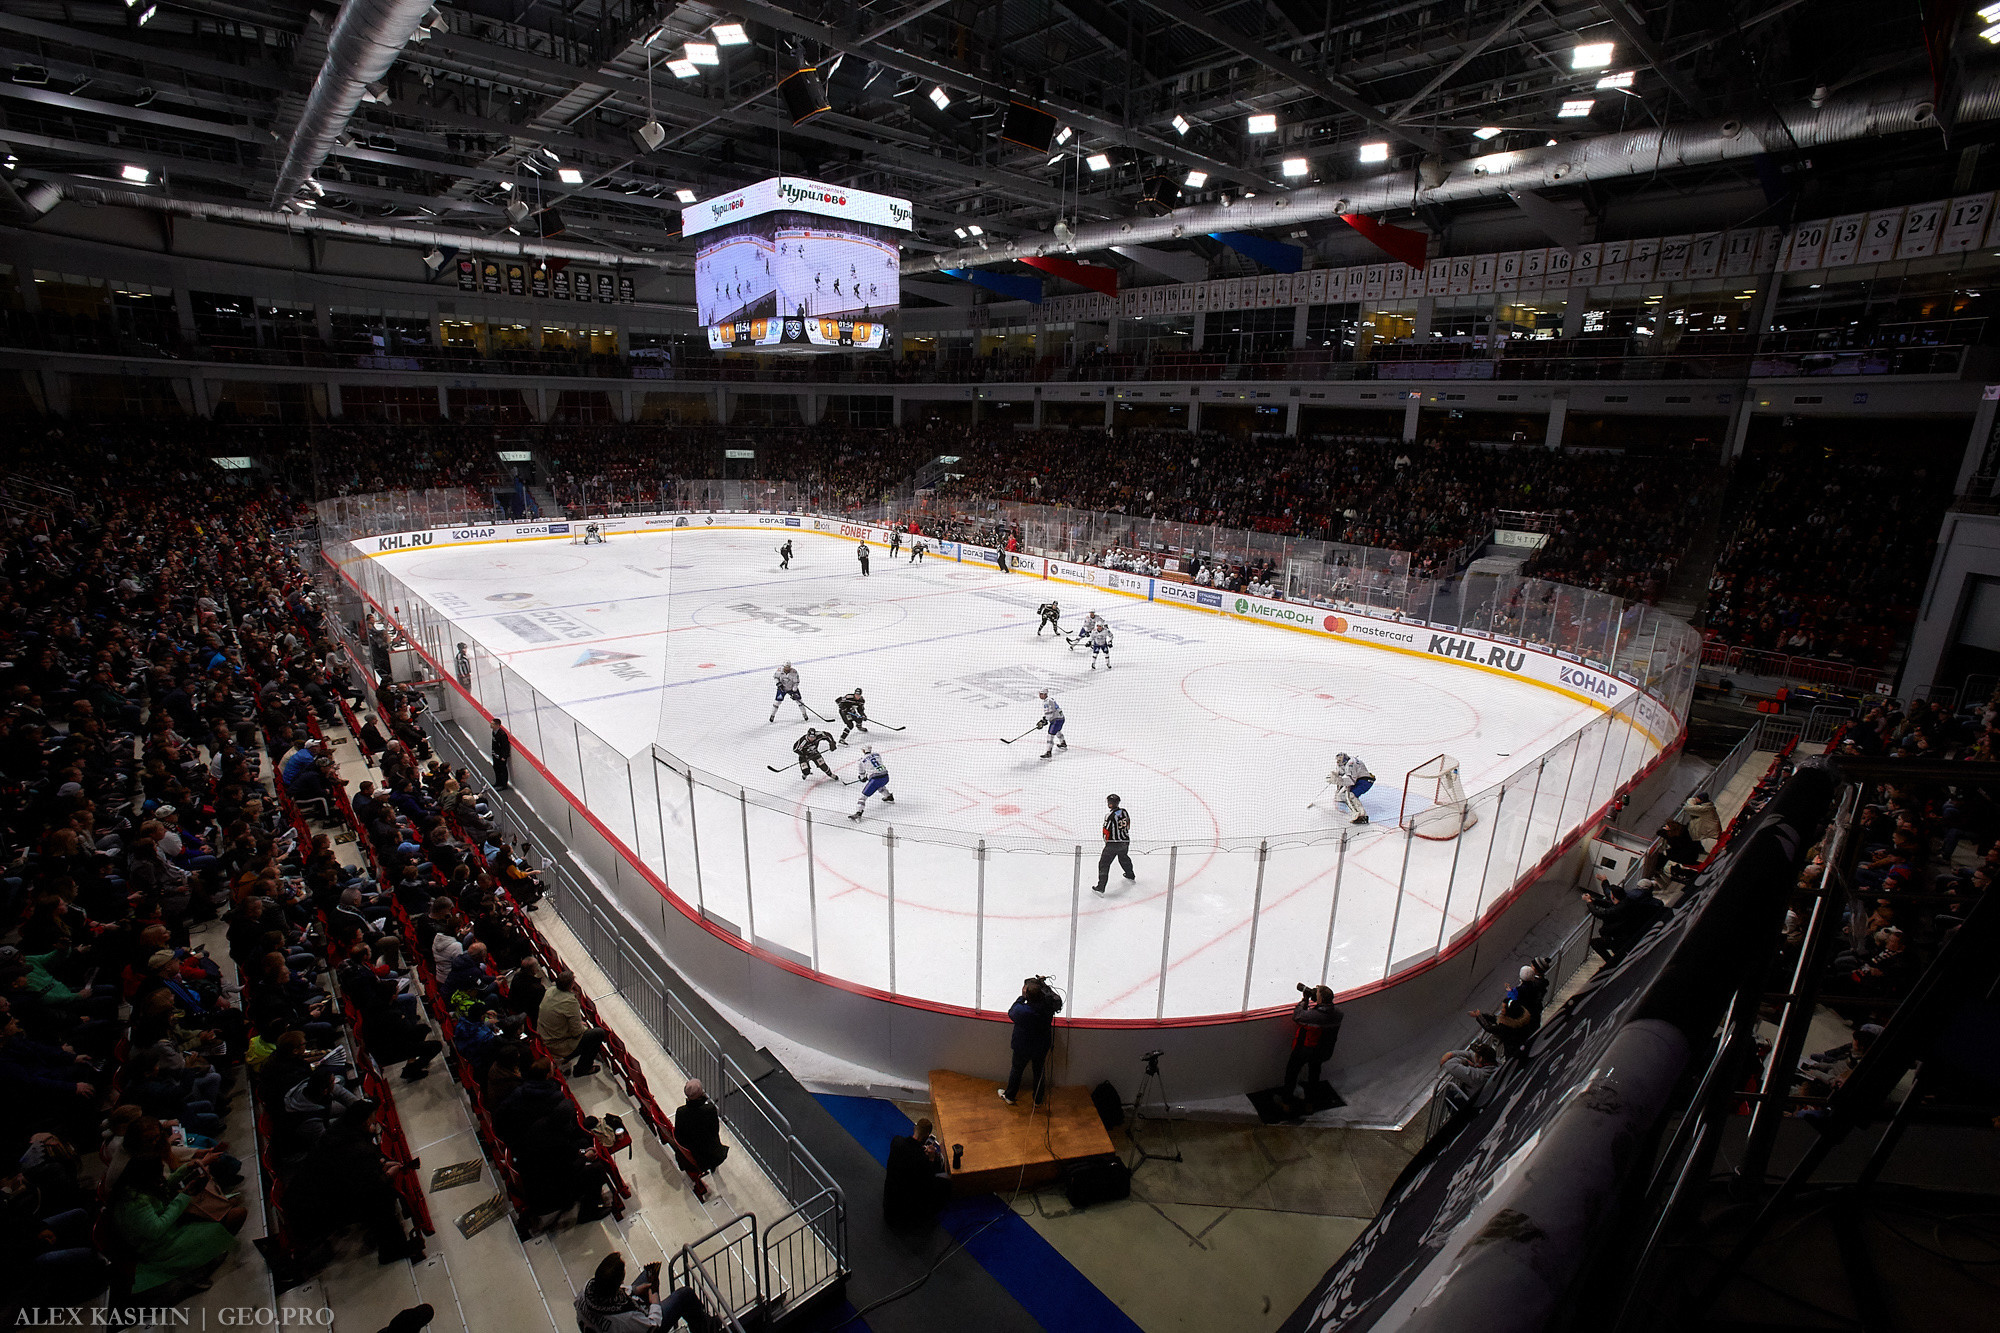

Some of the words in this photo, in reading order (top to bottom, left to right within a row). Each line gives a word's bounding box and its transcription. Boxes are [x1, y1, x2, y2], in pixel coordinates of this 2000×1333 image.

[782, 184, 847, 206] Чурилово
[711, 197, 744, 222] Чурилово
[1952, 204, 1984, 227] 12
[1874, 219, 1890, 238] 8
[1907, 212, 1937, 234] 24
[1797, 228, 1822, 248] 20
[1831, 223, 1858, 244] 13
[1611, 249, 1621, 264] 7
[1663, 244, 1686, 260] 22
[1504, 258, 1513, 273] 6
[1529, 257, 1538, 271] 5
[1552, 254, 1568, 269] 16
[1581, 252, 1592, 267] 8
[1369, 270, 1382, 283] 21
[1389, 268, 1403, 282] 13
[1454, 263, 1469, 277] 18
[1314, 275, 1321, 287] 5
[1333, 274, 1339, 287] 4
[1350, 272, 1363, 285] 10
[1126, 293, 1136, 304] 19
[1153, 290, 1163, 301] 13
[735, 321, 750, 333] 01:54
[756, 323, 761, 336] 1
[826, 322, 833, 337] 1
[838, 321, 854, 329] 01:54
[859, 325, 865, 339] 1
[725, 326, 730, 339] 1
[758, 517, 785, 525] СОГАЗ
[452, 528, 496, 540] КОНАР
[516, 526, 548, 535] СОГАЗ
[840, 524, 872, 540] FONBET
[378, 532, 433, 550] KHL.RU
[962, 548, 984, 559] СОГАЗ
[1019, 560, 1035, 570] ЮГК
[1120, 579, 1141, 590] ЧТПЗ
[1161, 585, 1196, 600] СОГАЗ
[1251, 603, 1315, 625] МЕГАФОН
[530, 611, 595, 639] СОГАЗ
[1352, 624, 1414, 643] mastercard
[1428, 634, 1525, 672] KHL.RU
[1559, 665, 1618, 699] КОНАР
[1118, 818, 1127, 829] 35
